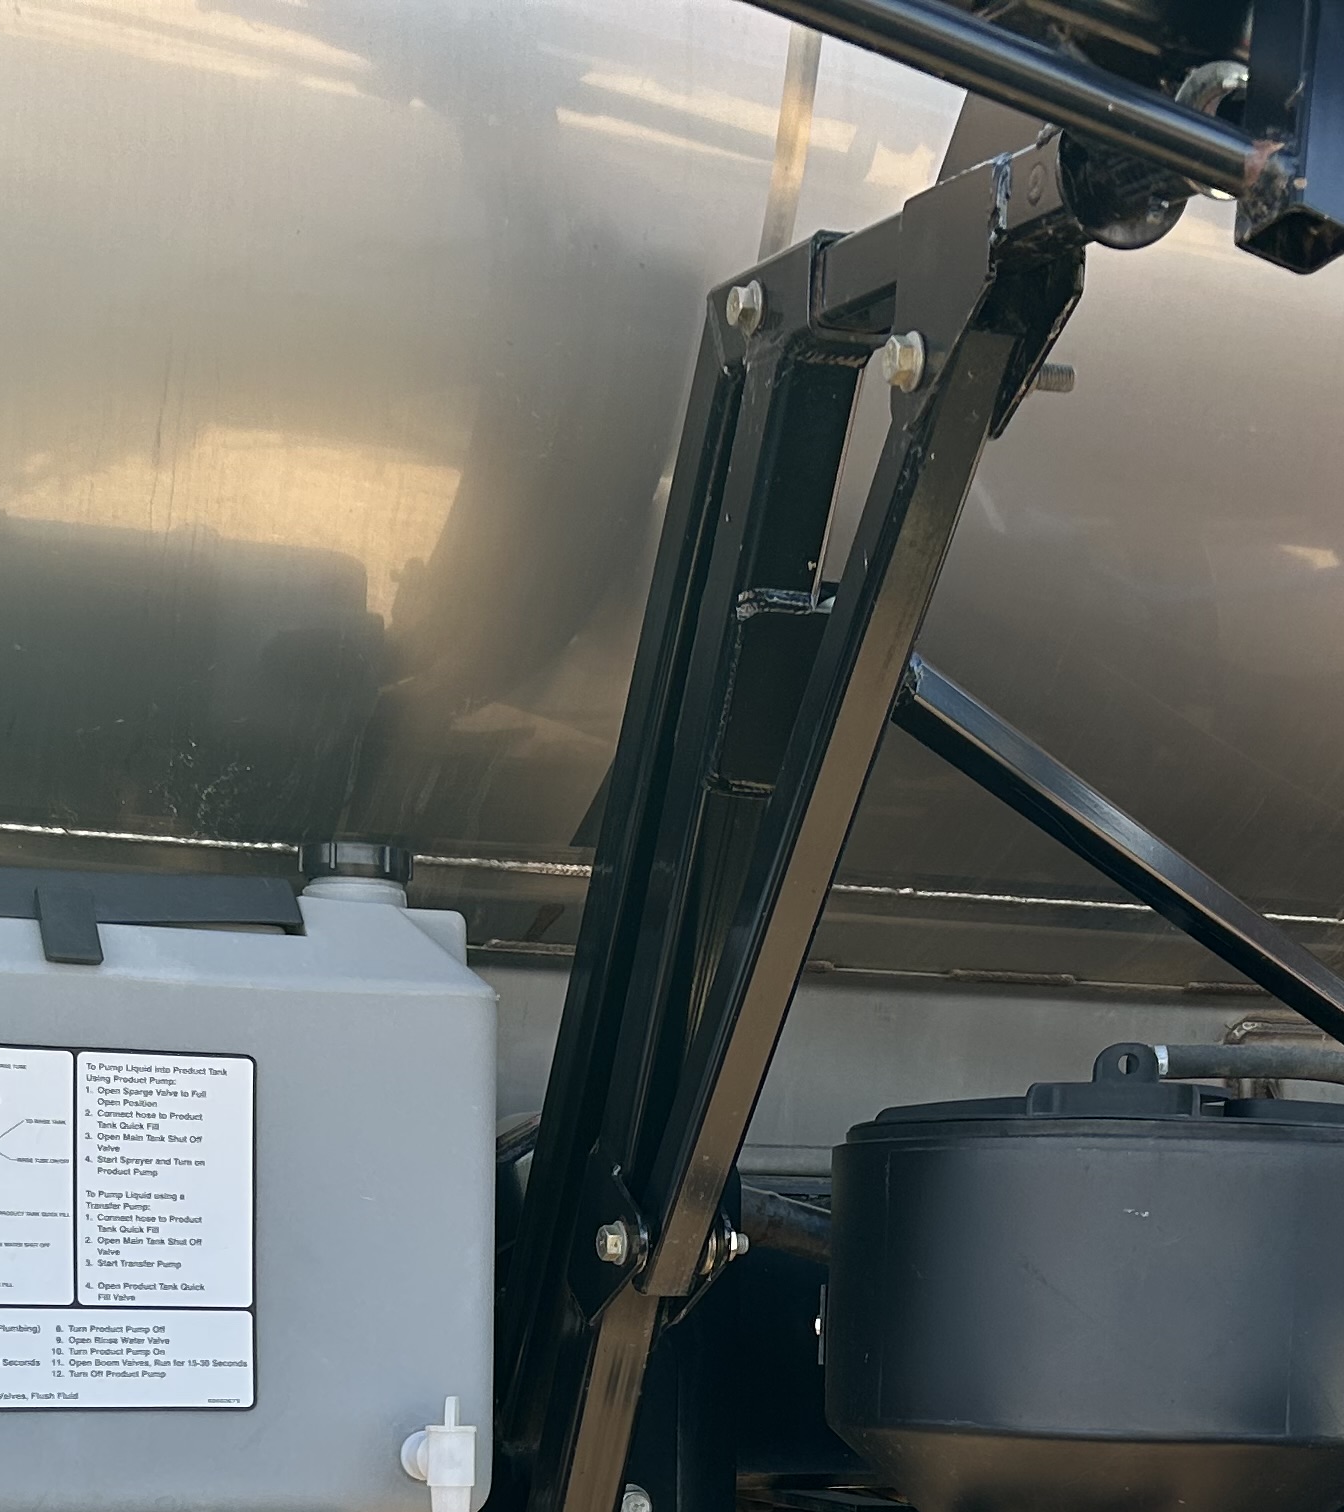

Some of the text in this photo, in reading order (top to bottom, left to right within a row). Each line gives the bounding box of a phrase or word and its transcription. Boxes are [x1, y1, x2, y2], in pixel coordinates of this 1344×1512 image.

[99, 1064, 124, 1073] Pump
[126, 1065, 153, 1074] Liquid
[173, 1067, 207, 1075] Product
[208, 1068, 228, 1076] Tank
[97, 1087, 121, 1096] Open
[123, 1088, 154, 1097] Sparge
[155, 1089, 179, 1097] Valve
[191, 1090, 207, 1098] Full
[97, 1098, 121, 1107] Open
[97, 1110, 133, 1118] Connect
[136, 1111, 157, 1119] hose
[97, 1121, 118, 1129] Tank
[120, 1122, 145, 1130] Quick
[97, 1133, 121, 1142] Open
[120, 1157, 154, 1166] Sprayer
[173, 1158, 193, 1166] Turn
[133, 1168, 159, 1177] Pump
[98, 1191, 124, 1200] Pump
[125, 1192, 152, 1200] Liquid
[97, 1214, 134, 1222] Connect
[97, 1225, 118, 1233] Tank
[97, 1237, 121, 1245] Open
[168, 1238, 187, 1246] Shut
[97, 1259, 118, 1267] Start
[157, 1261, 182, 1269] Pump
[98, 1282, 121, 1291] Open
[180, 1283, 206, 1291] Quick
[90, 1325, 124, 1333] Product
[126, 1326, 151, 1334] Pump
[68, 1337, 92, 1345] Open
[126, 1348, 151, 1357] Pump
[69, 1359, 93, 1368] Open
[212, 1359, 248, 1367] Seconds
[91, 1370, 104, 1378] Off
[141, 1370, 167, 1378] Pump
